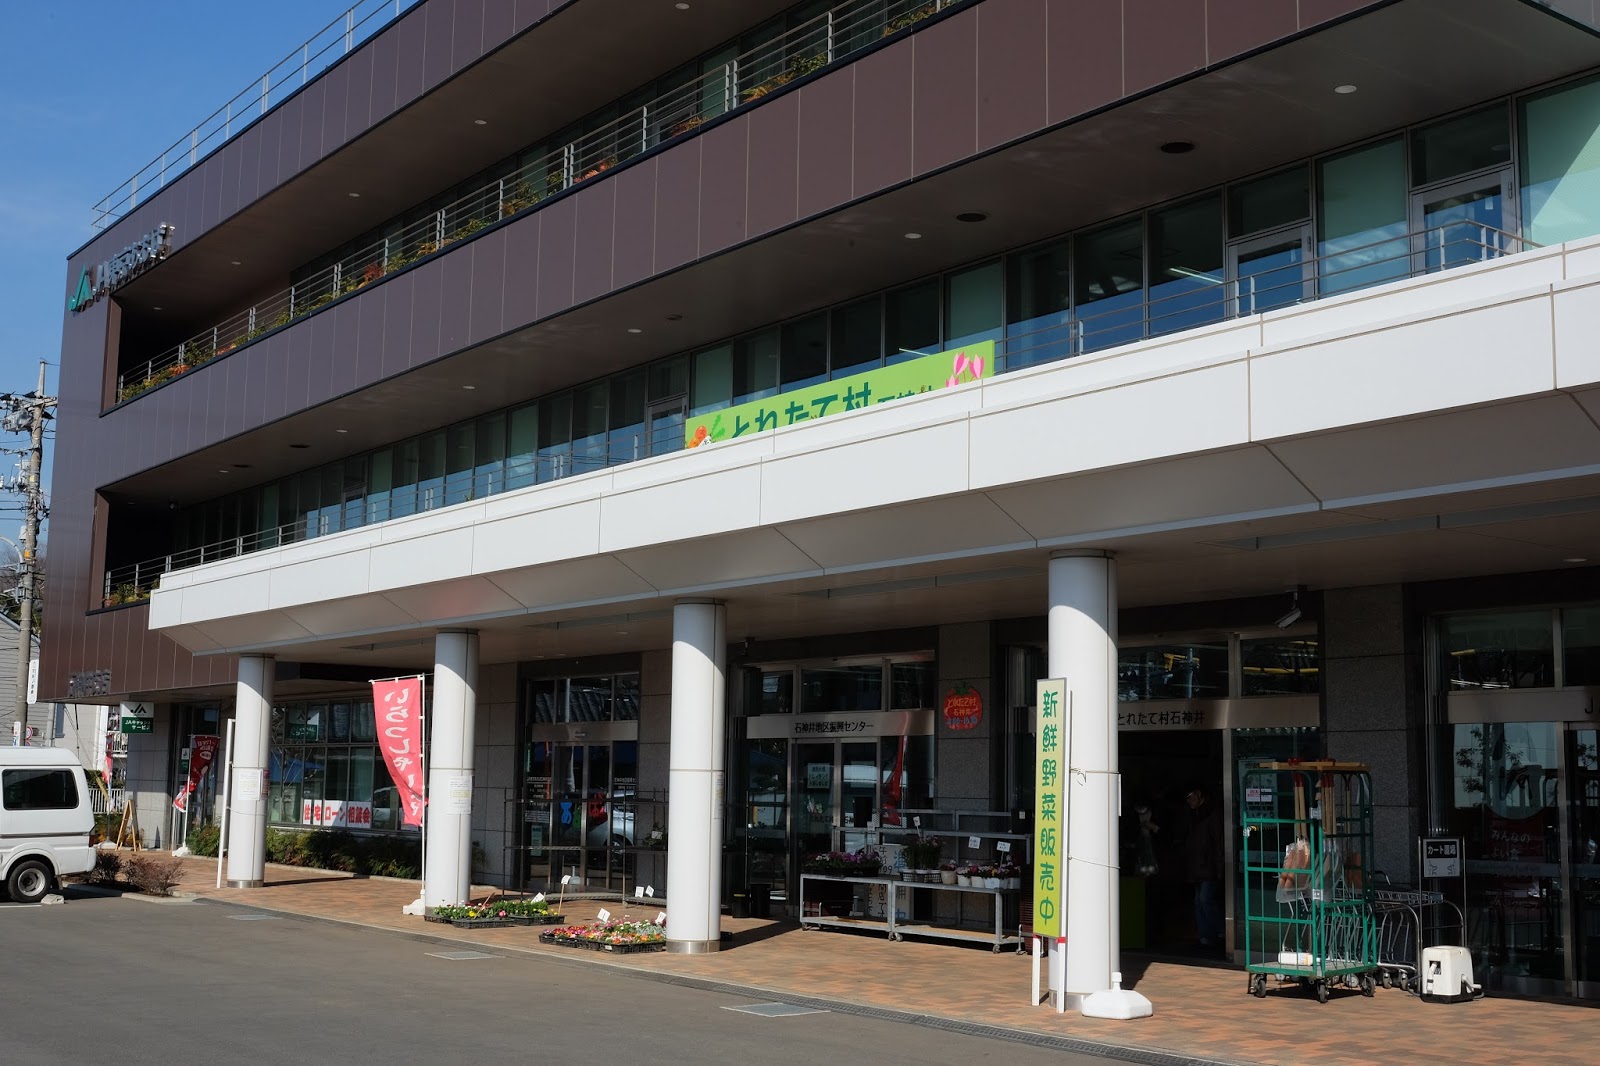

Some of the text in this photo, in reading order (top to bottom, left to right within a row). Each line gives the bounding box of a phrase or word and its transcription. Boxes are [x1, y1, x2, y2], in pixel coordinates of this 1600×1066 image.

[1118, 710, 1205, 725] とれたて村石神井
[795, 721, 874, 734] 石神井地区振興センター
[1038, 689, 1059, 925] 新鮮野菜販売中
